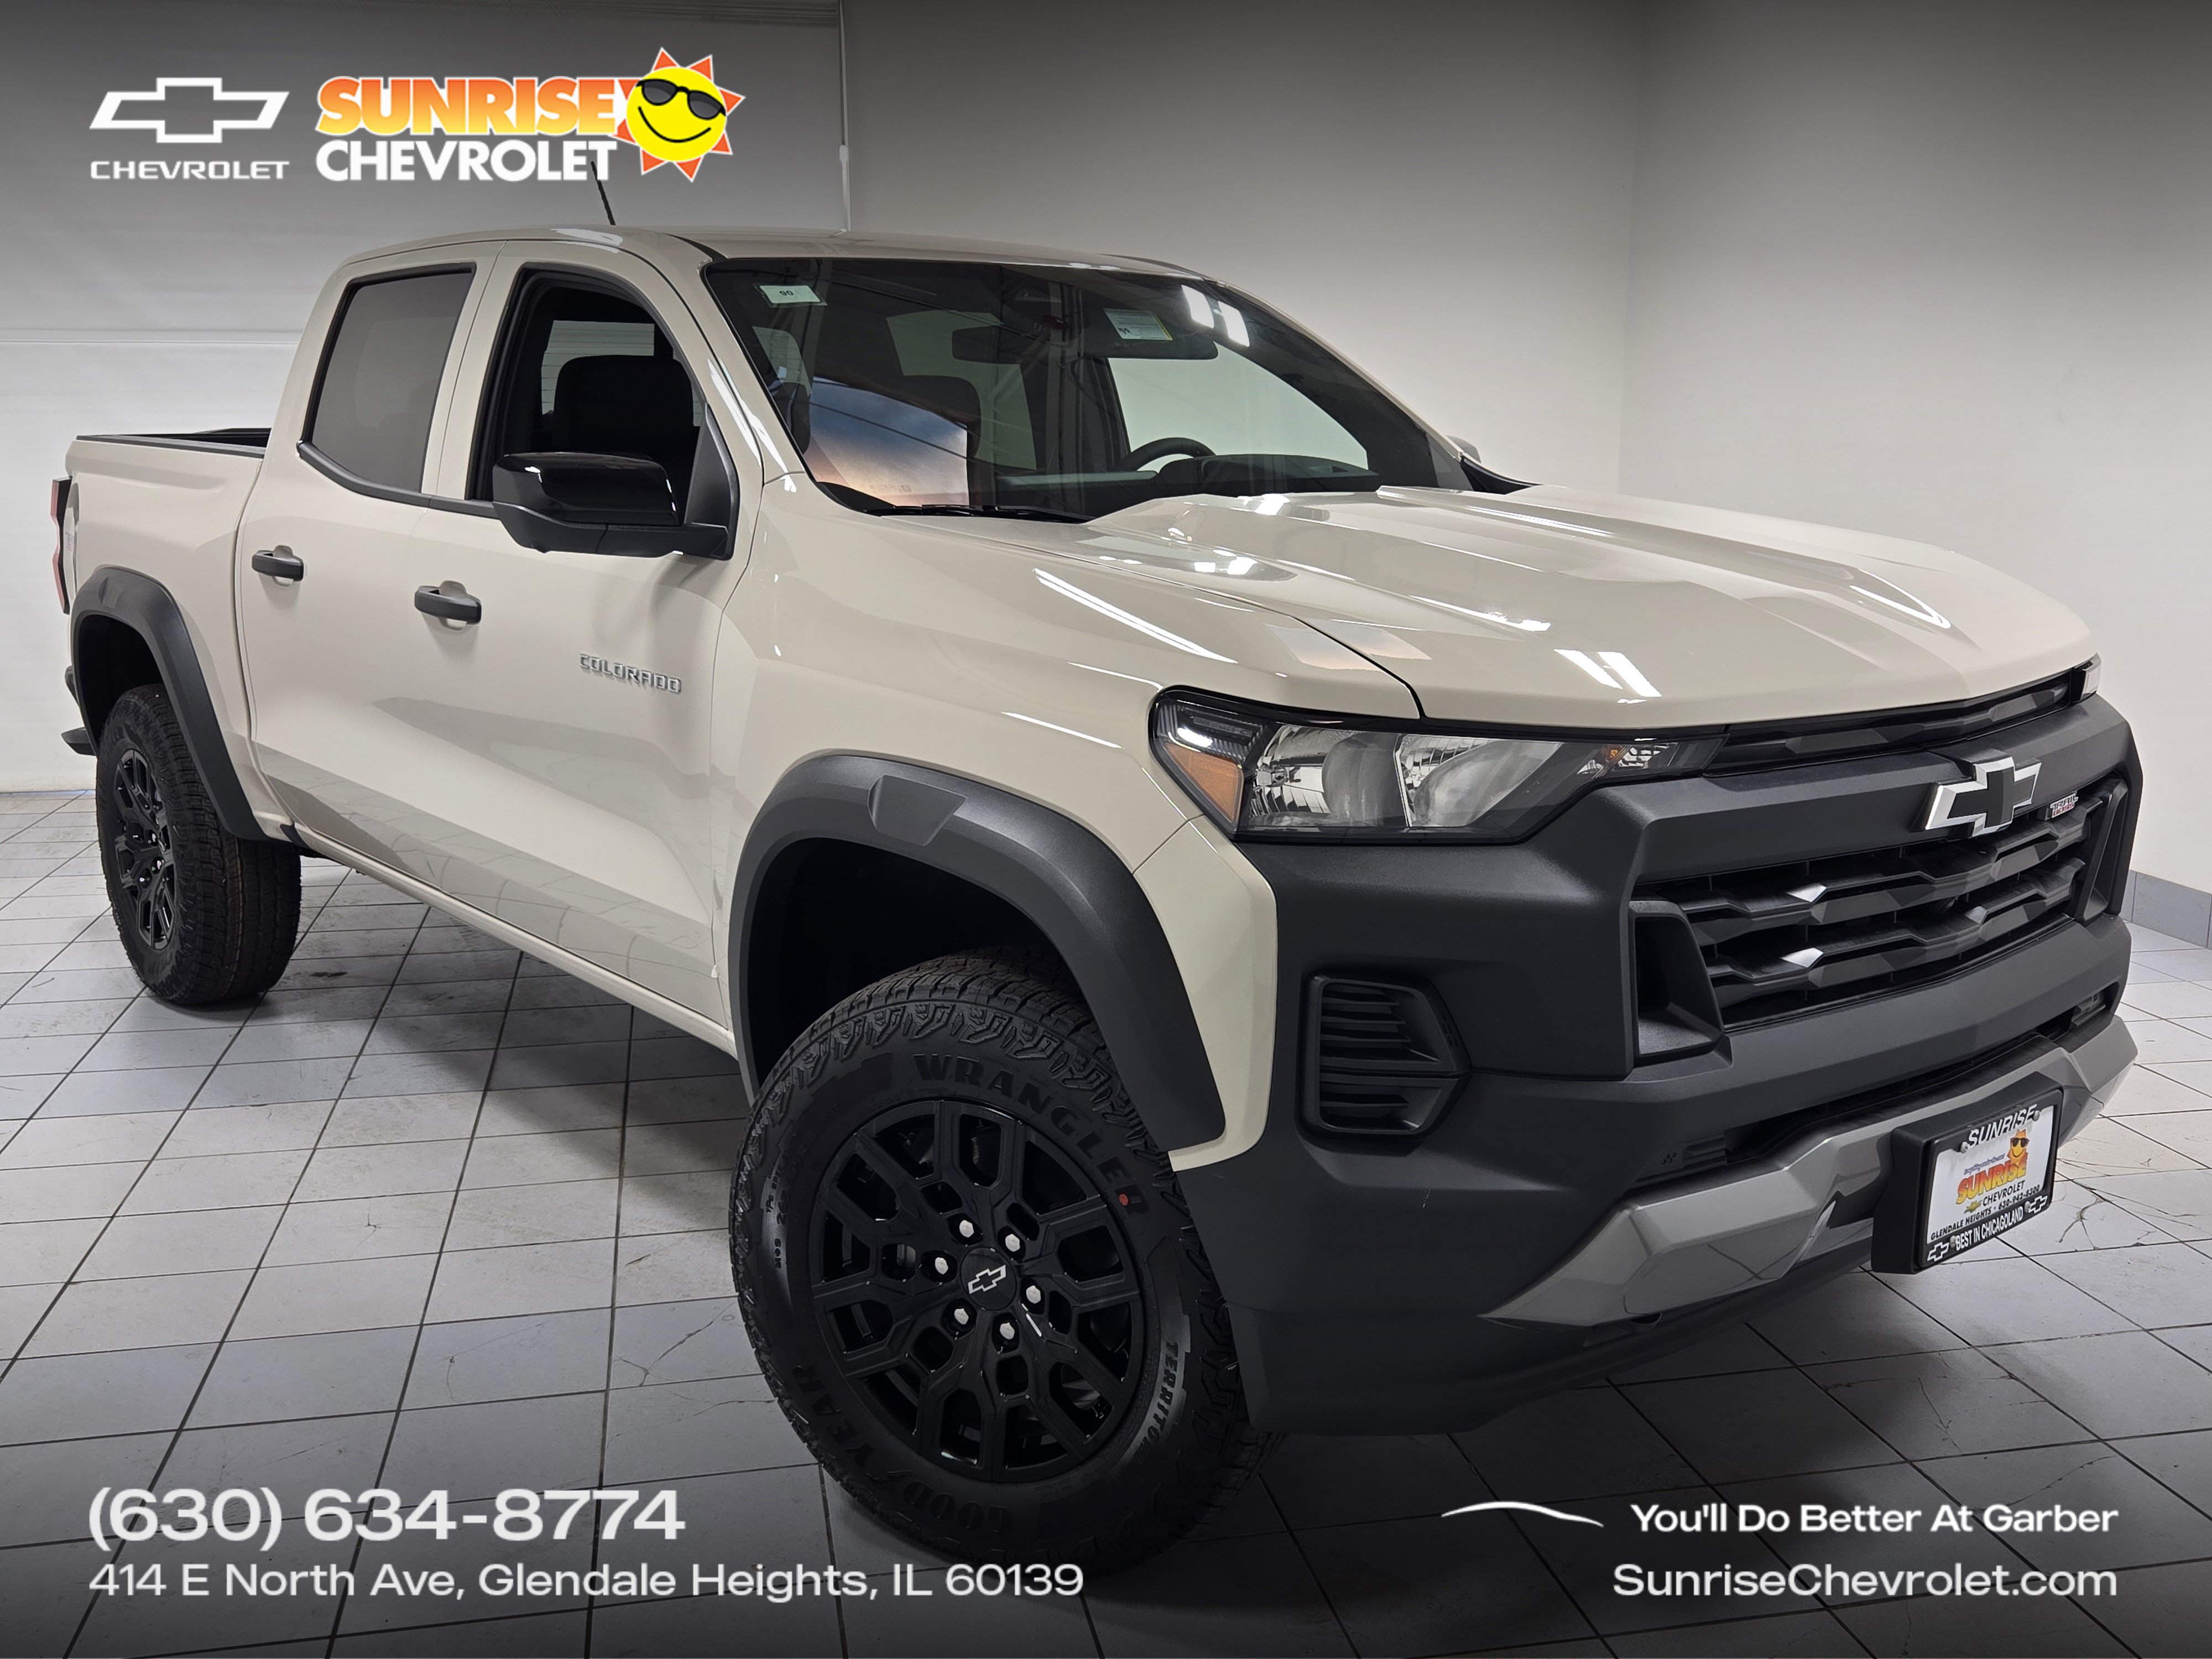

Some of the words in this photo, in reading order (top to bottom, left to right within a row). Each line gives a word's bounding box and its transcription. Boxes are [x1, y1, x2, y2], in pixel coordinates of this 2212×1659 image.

[579, 653, 682, 693] COLORADO
[2051, 794, 2078, 810] TRAIL
[912, 1052, 1151, 1215] WRANGLER
[1966, 1104, 2037, 1147] SUNRISE
[1956, 1157, 2028, 1205] SUNRISE
[1983, 1180, 2025, 1206] CHEVROLET
[1931, 1219, 1964, 1240] GLENDALE
[1965, 1208, 1991, 1225] HEIGHTS
[1955, 1229, 1973, 1251] BEST
[1974, 1226, 1980, 1243] IN
[1981, 1206, 2023, 1239] CHICAGOLAND
